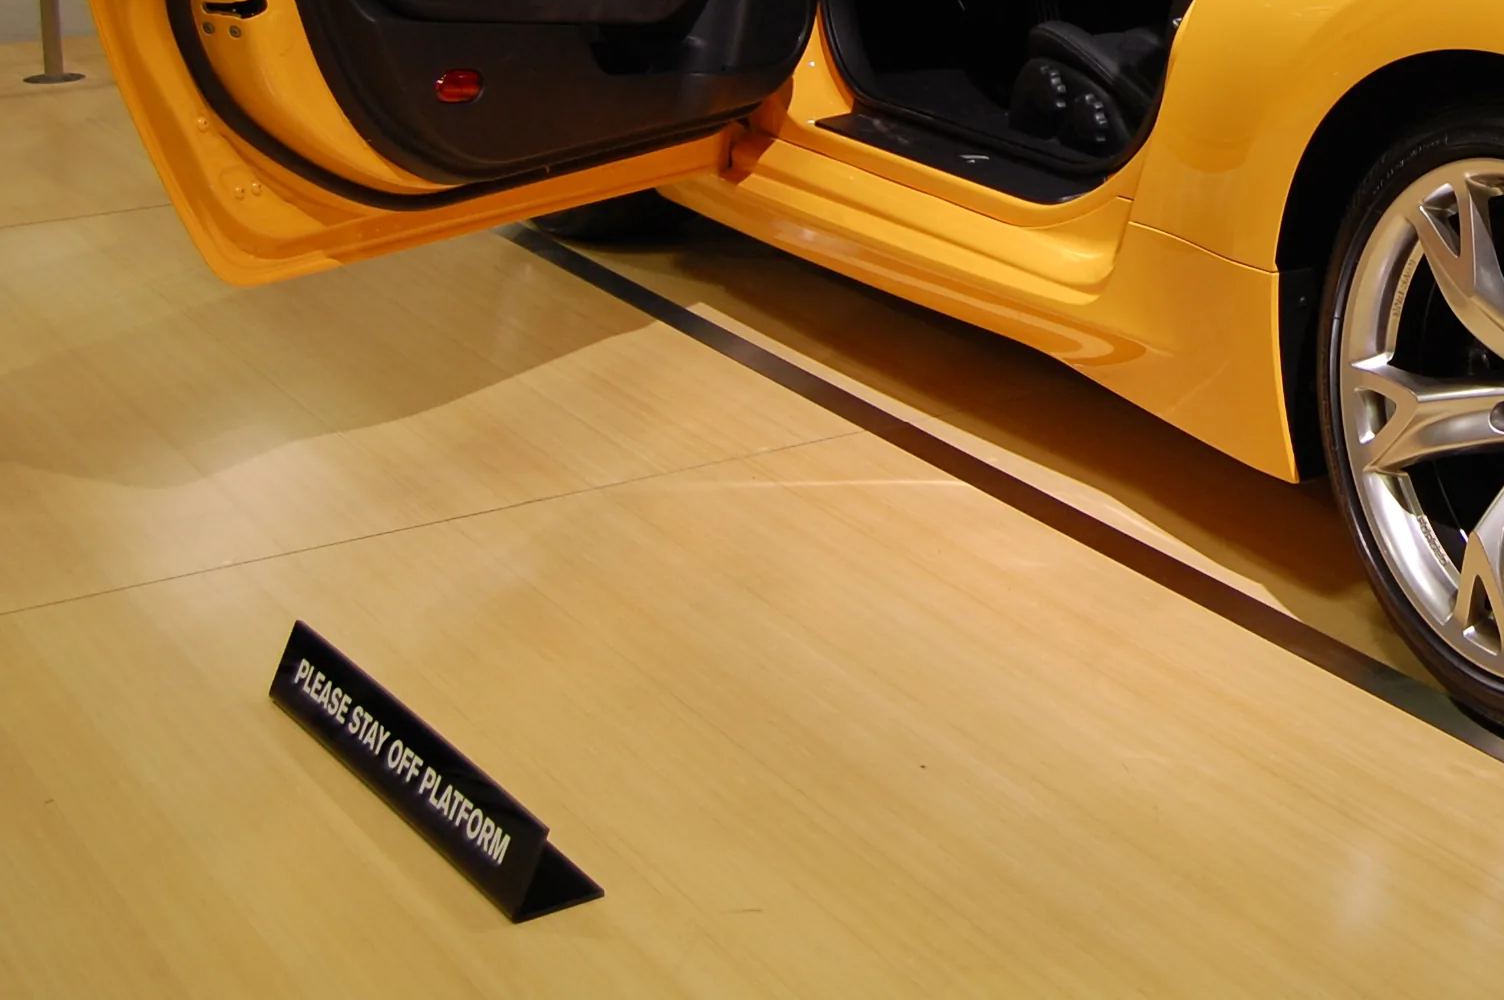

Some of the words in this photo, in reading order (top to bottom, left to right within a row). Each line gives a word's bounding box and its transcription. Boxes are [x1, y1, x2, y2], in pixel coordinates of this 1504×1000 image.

[294, 658, 353, 725] PLEASE
[347, 704, 391, 756] STAY
[387, 738, 424, 783] OFF
[418, 765, 512, 865] PLATFORM
